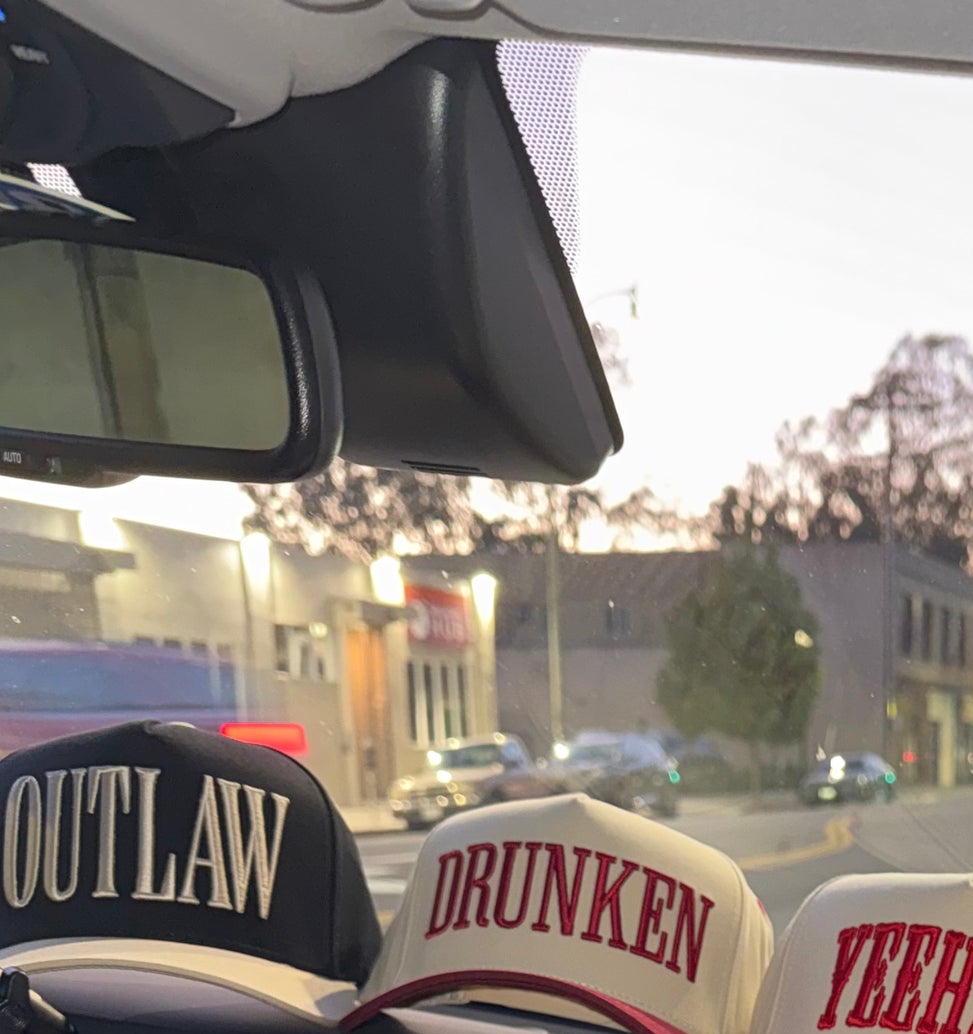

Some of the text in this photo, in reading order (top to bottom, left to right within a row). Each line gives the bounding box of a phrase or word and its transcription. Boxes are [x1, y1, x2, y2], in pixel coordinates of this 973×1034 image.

[3, 451, 22, 464] AUTO
[3, 765, 291, 920] OUTLAW
[425, 841, 715, 983] DRUNKEN
